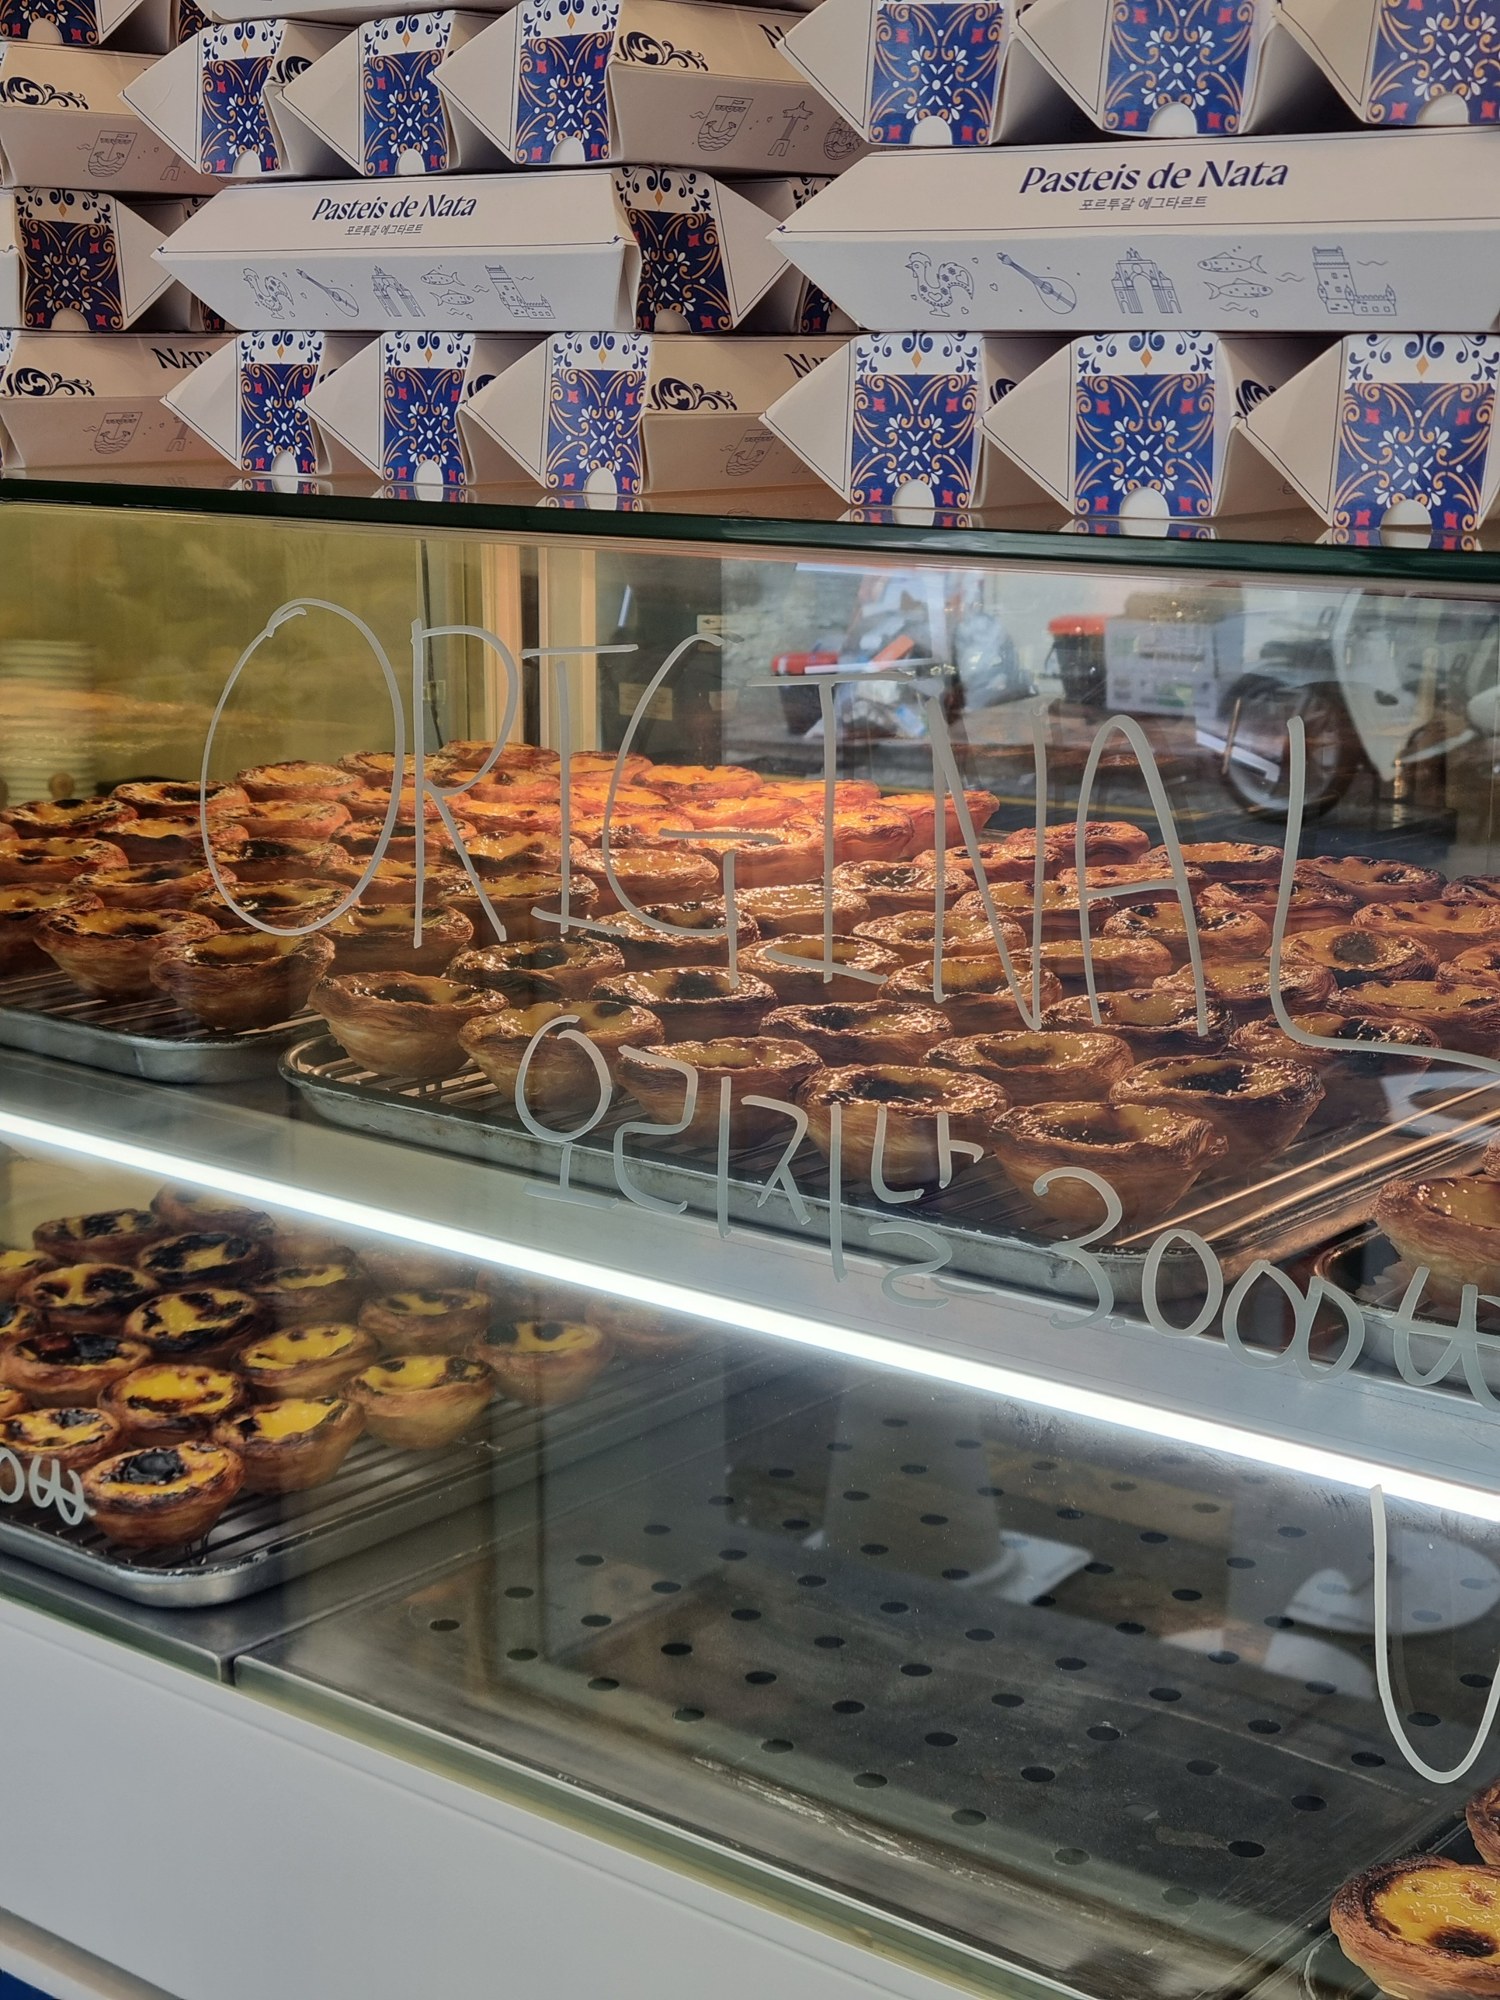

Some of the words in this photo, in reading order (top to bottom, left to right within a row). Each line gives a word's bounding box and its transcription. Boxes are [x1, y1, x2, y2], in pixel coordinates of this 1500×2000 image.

[1018, 163, 1141, 194] Pasteis
[1146, 162, 1192, 190] de
[1197, 159, 1289, 187] Nata
[311, 196, 388, 221] Pasteis
[389, 195, 419, 218] de
[419, 194, 477, 217] Nata
[1078, 197, 1135, 211] 포르투갈
[1138, 195, 1208, 210] 에그타르트
[345, 225, 380, 236] 포르투갈
[380, 224, 424, 235] 에그타르트
[150, 347, 214, 369] NAT
[200, 597, 1500, 1076] ORIGINAL
[514, 1013, 998, 1310] 오리지날
